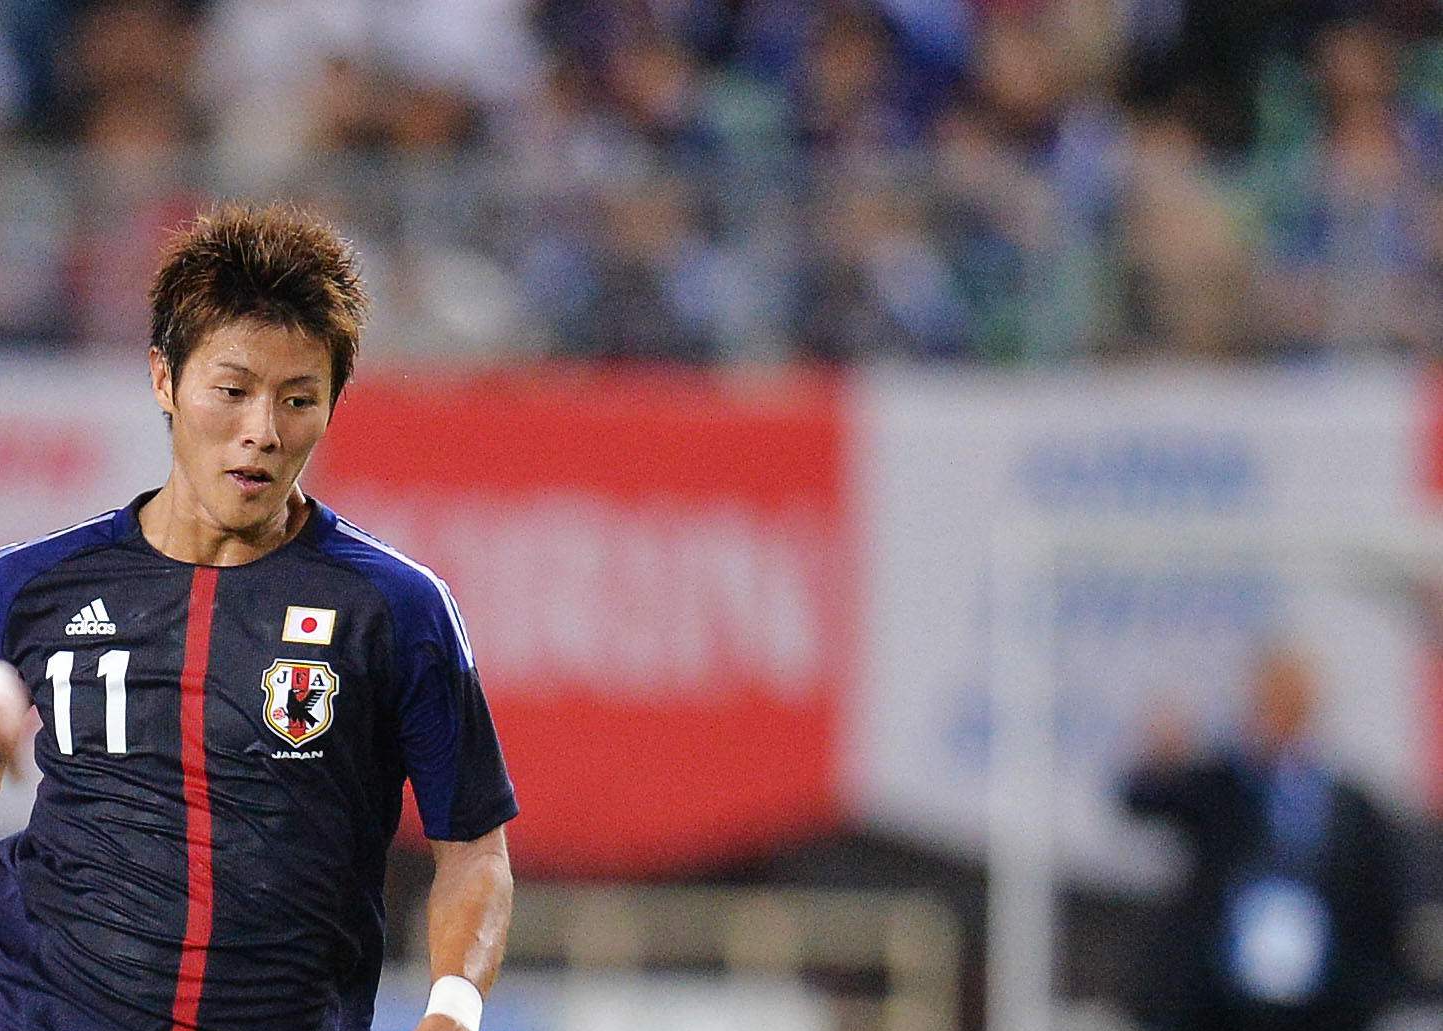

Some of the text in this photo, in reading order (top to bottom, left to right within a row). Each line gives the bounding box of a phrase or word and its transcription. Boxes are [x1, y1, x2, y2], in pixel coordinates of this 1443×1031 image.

[65, 622, 116, 635] adidas
[45, 649, 130, 755] 11
[271, 750, 324, 760] JAPAN
